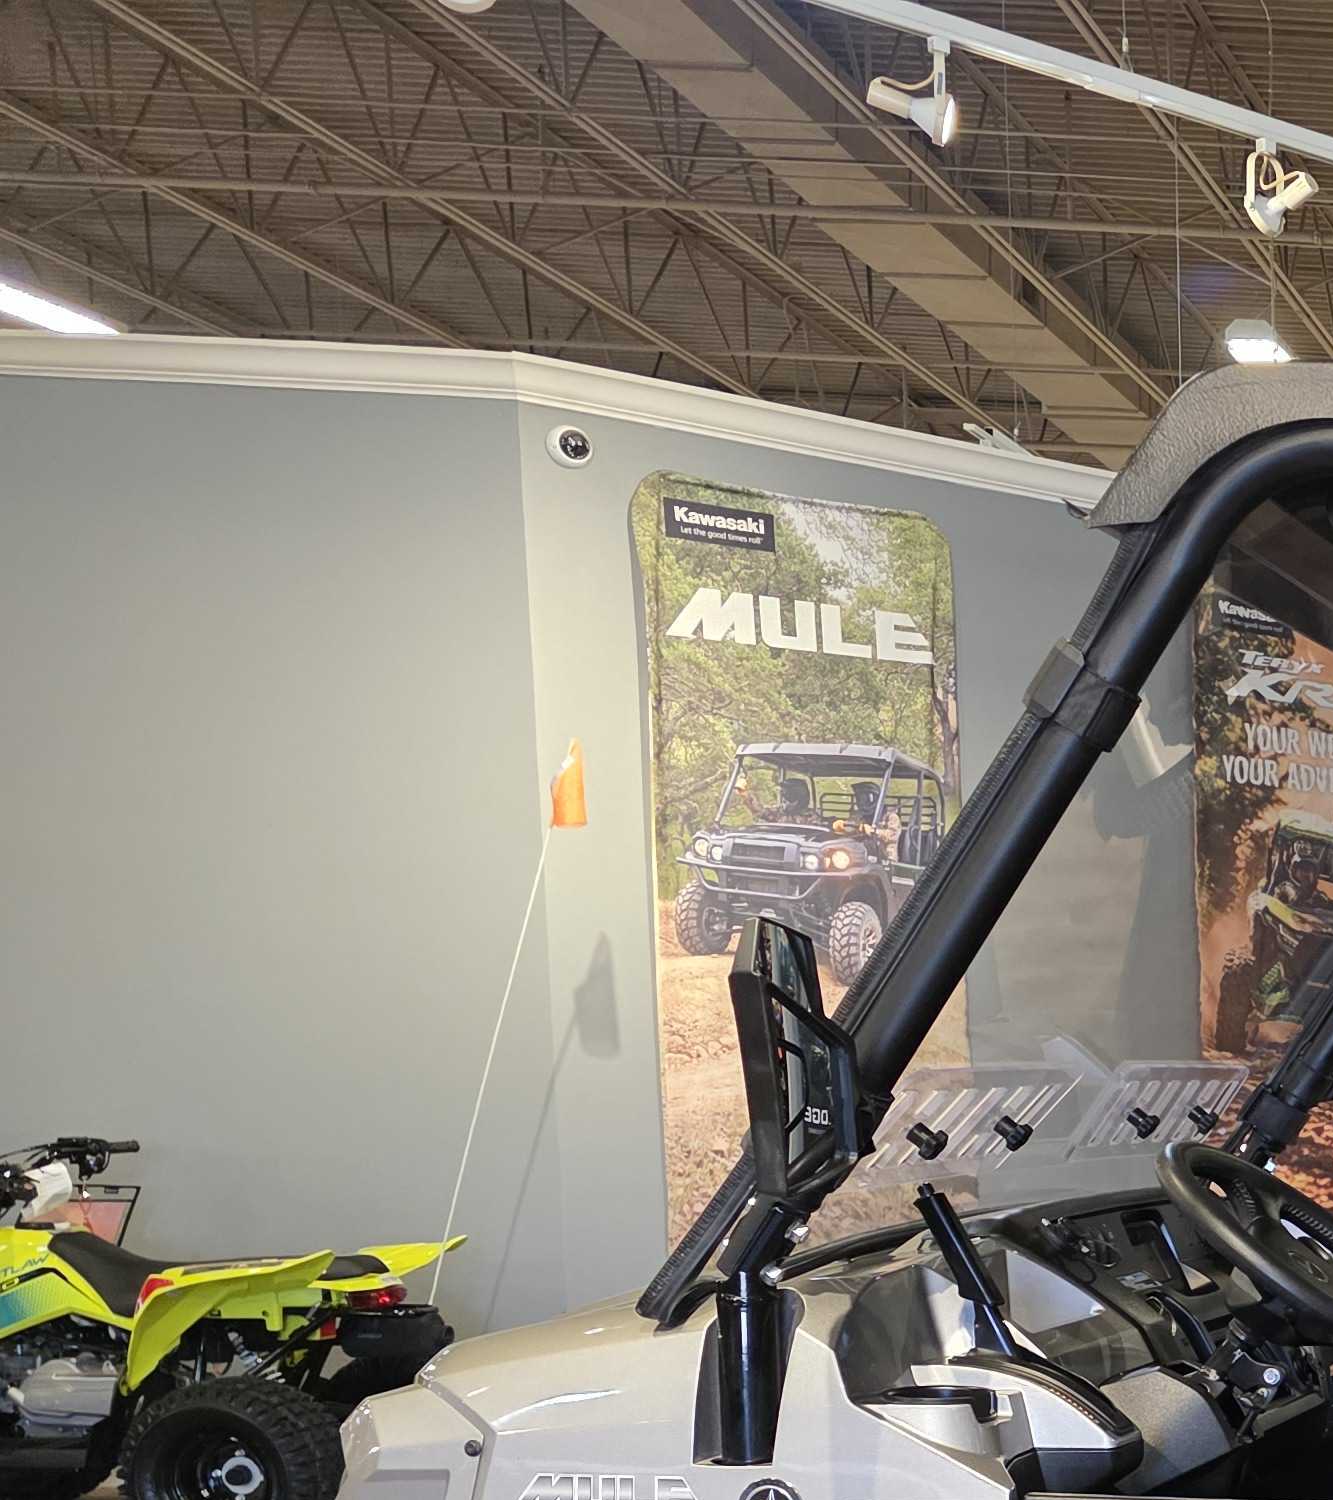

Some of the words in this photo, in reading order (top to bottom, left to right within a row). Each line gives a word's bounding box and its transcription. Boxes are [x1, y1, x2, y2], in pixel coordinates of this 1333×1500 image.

[673, 506, 765, 535] Kawasaki
[680, 525, 692, 535] Let
[694, 528, 706, 538] the
[708, 530, 725, 541] good
[727, 532, 747, 543] times
[665, 587, 935, 665] MULE
[1243, 722, 1300, 754] YOUR
[1222, 753, 1280, 788] YOUR
